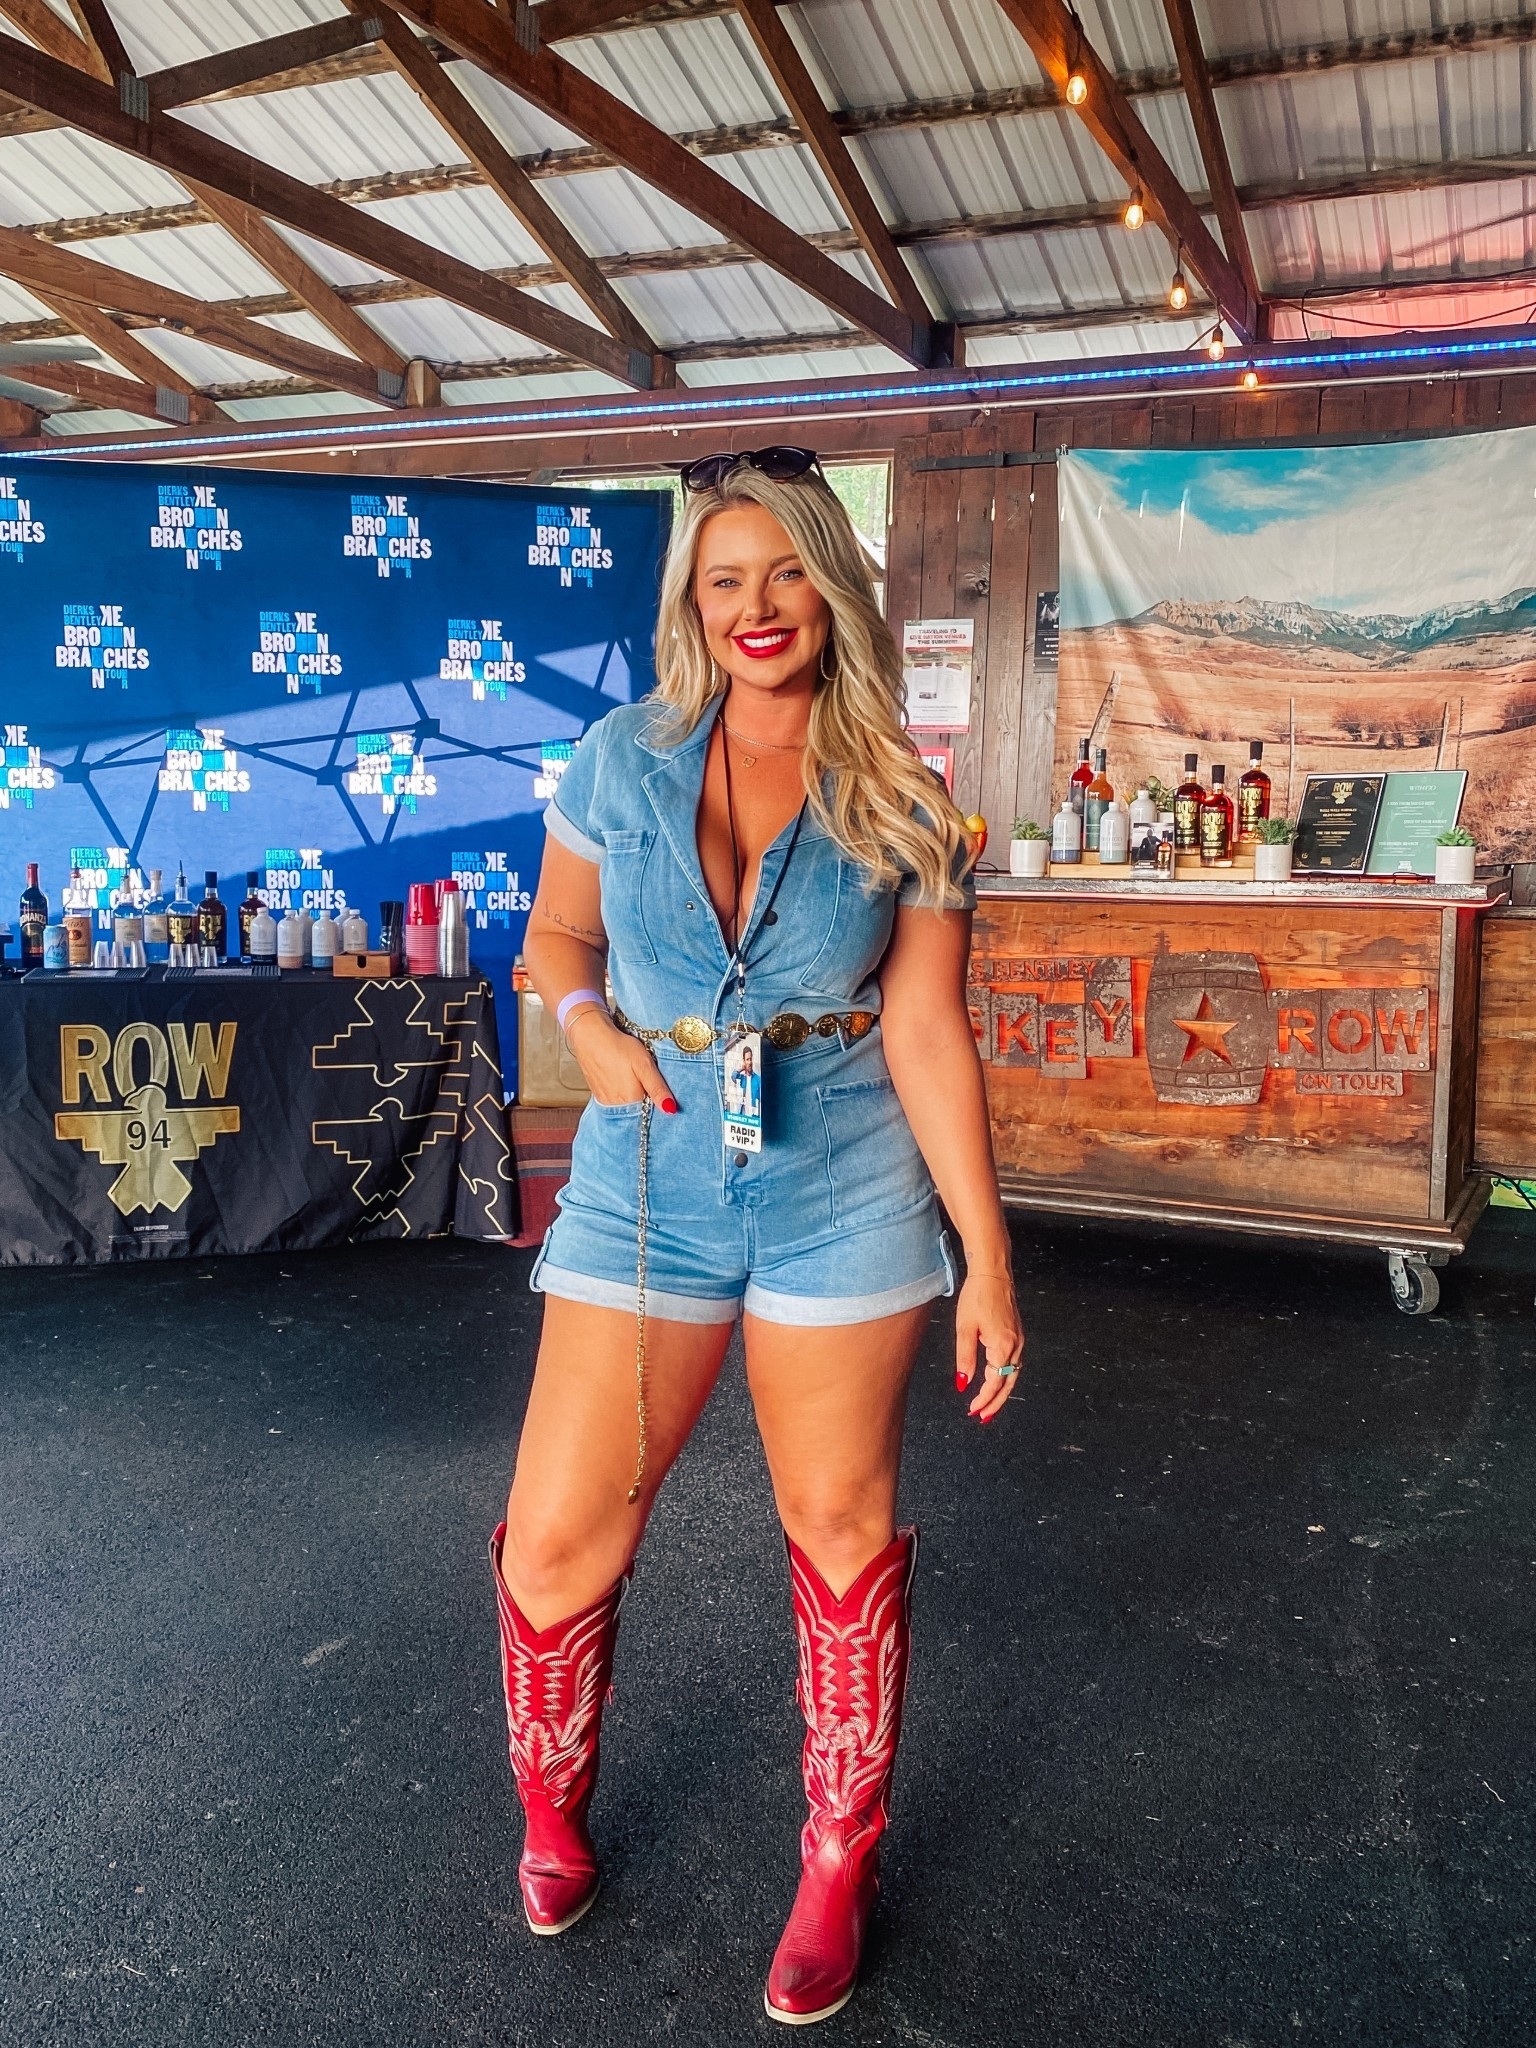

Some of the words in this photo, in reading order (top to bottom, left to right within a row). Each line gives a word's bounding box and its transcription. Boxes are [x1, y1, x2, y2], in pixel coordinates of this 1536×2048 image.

[158, 486, 188, 496] DIERKS
[158, 496, 195, 506] BENTLEY
[351, 495, 380, 505] DIERKS
[351, 505, 387, 516] BENTLEY
[537, 506, 565, 516] DIERKS
[537, 516, 571, 526] BENTLEY
[63, 605, 94, 615] DIERKS
[64, 615, 101, 626] BENTLEY
[259, 611, 290, 622] DIERKS
[260, 621, 296, 632] BENTLEY
[448, 619, 476, 629] DIERKS
[448, 629, 482, 640] BENTLEY
[541, 750, 576, 760] BENTLE
[265, 850, 295, 860] DIERKS
[452, 852, 479, 862] DIERKS
[265, 859, 301, 869] BENTLEY
[452, 862, 486, 871] BENTLEY
[992, 959, 1097, 979] BENTLEY
[1277, 1007, 1426, 1055] ROW
[60, 1021, 238, 1103] ROW
[1301, 1075, 1332, 1090] ON
[1337, 1075, 1396, 1091] TOUR
[126, 1118, 173, 1151] 94
[731, 1126, 756, 1137] RADIO
[736, 1136, 750, 1144] VIP
